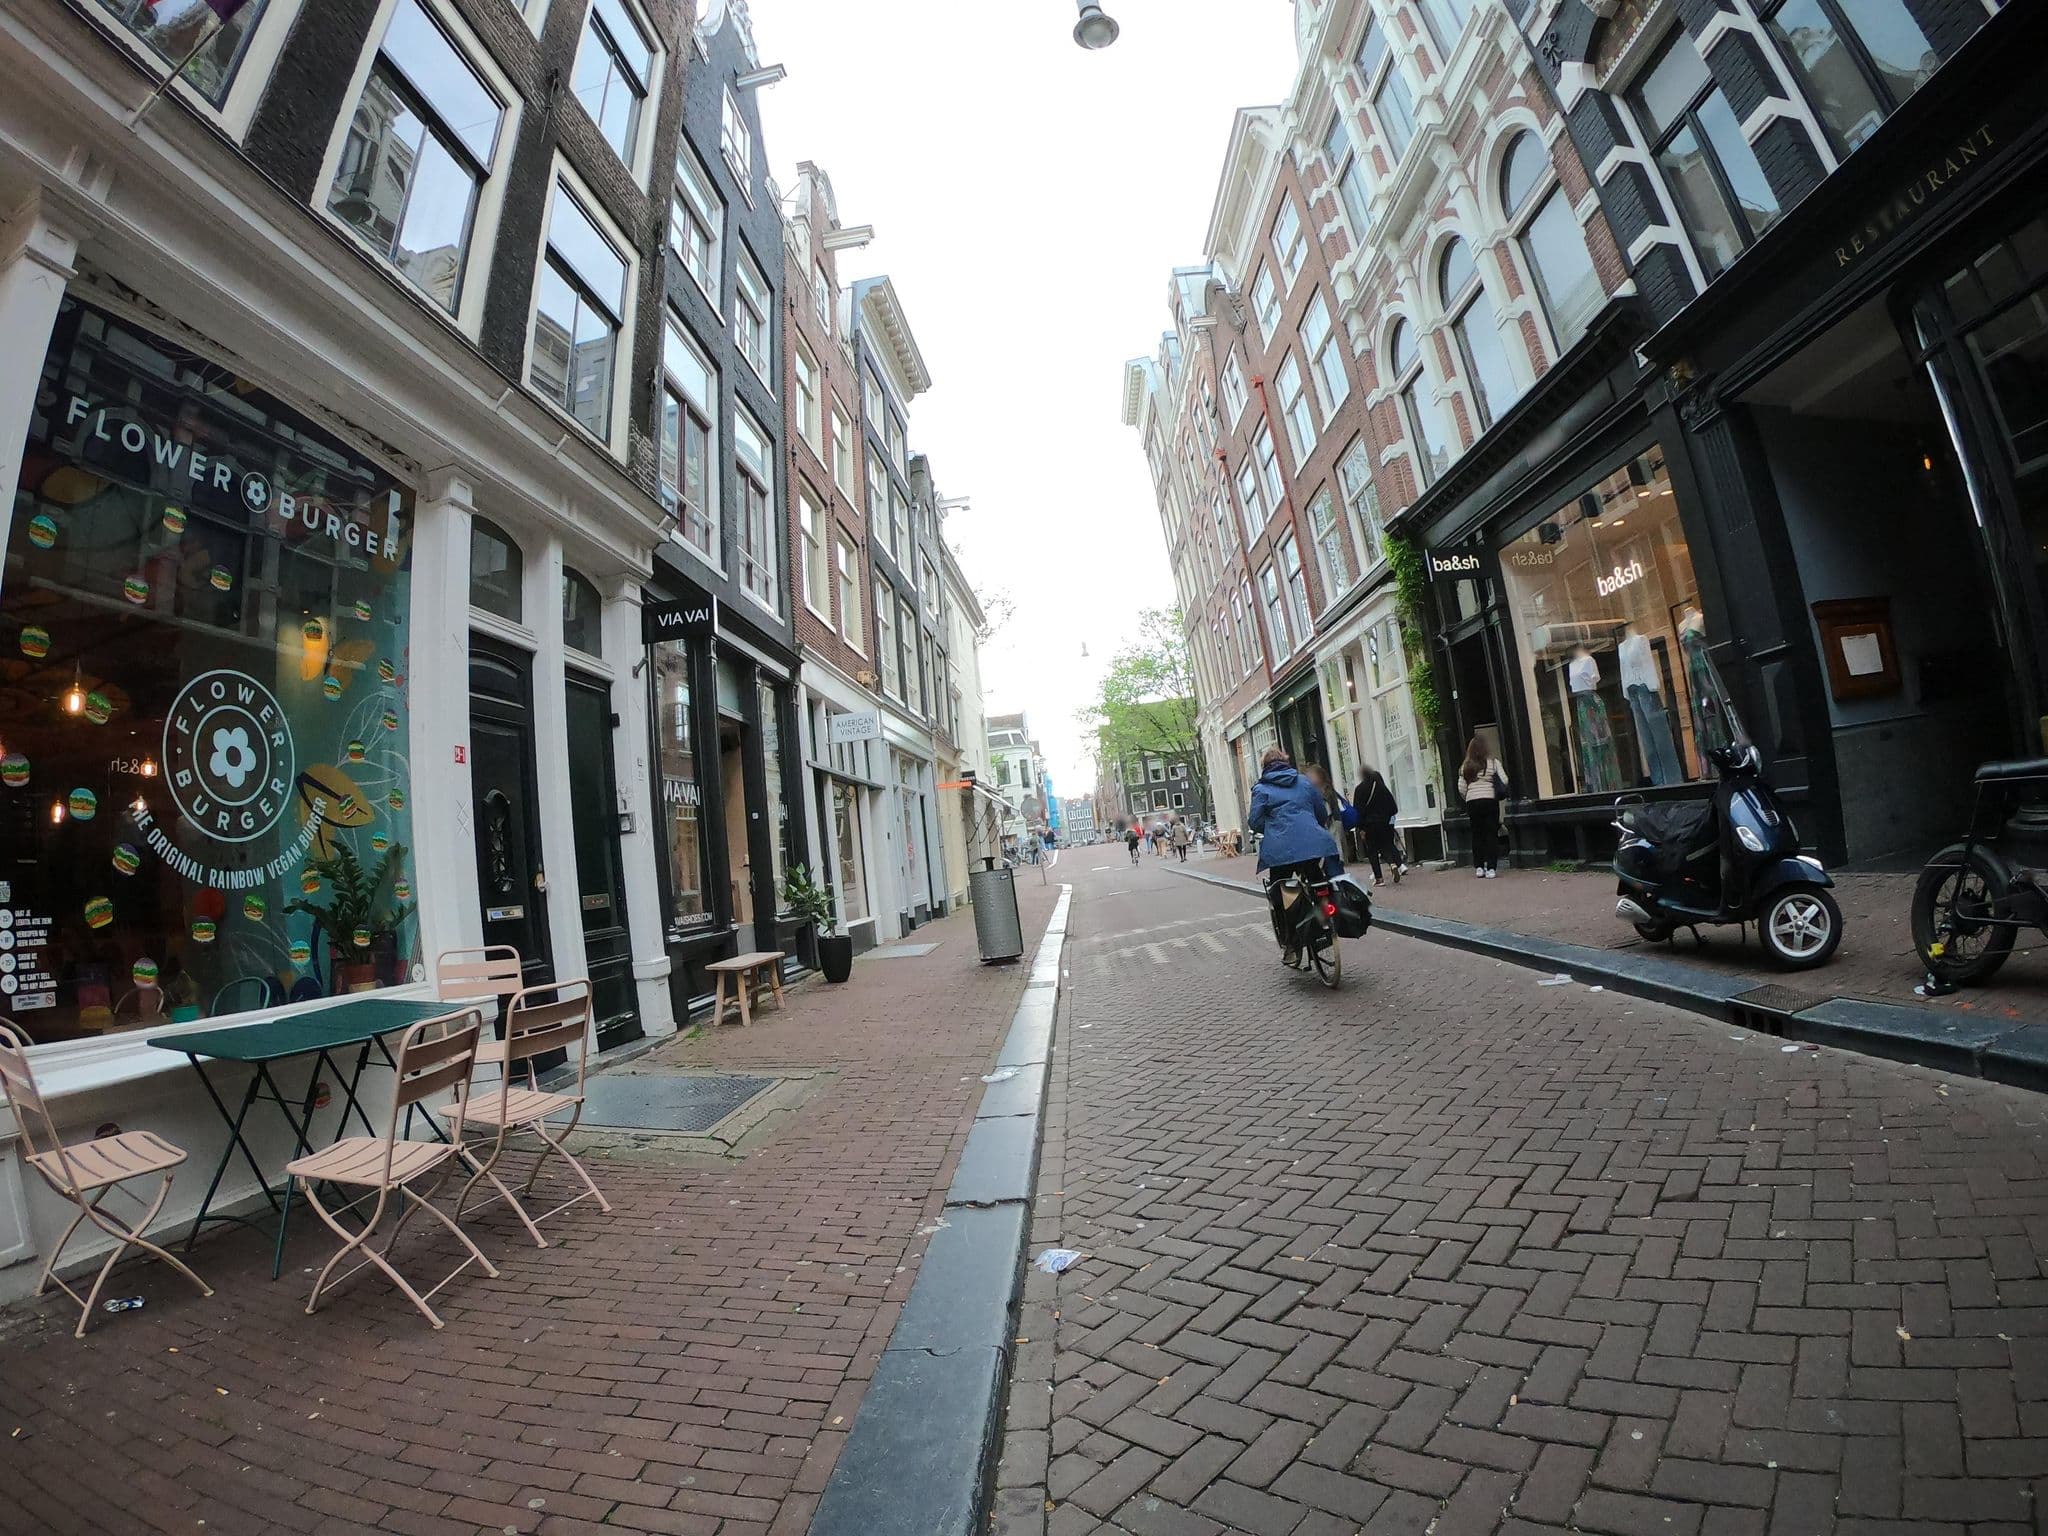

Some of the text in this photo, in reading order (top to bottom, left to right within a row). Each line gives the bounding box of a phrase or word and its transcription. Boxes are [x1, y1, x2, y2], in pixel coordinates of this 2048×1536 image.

[66, 395, 400, 562] FLOWER BURGER
[1432, 555, 1480, 572] ba&sh
[1596, 559, 1644, 597] ba&sh
[658, 607, 709, 627] VIA VAI
[175, 681, 286, 748] FLOWER
[836, 717, 874, 729] AMERICAN
[840, 725, 872, 736] VINTAGE
[175, 768, 285, 831] BURGER
[683, 783, 700, 806] VAI
[147, 827, 203, 884] ORIGINAL
[208, 866, 265, 890] RAINBOW
[266, 844, 303, 880] VEGAN
[298, 796, 328, 854] BURGER
